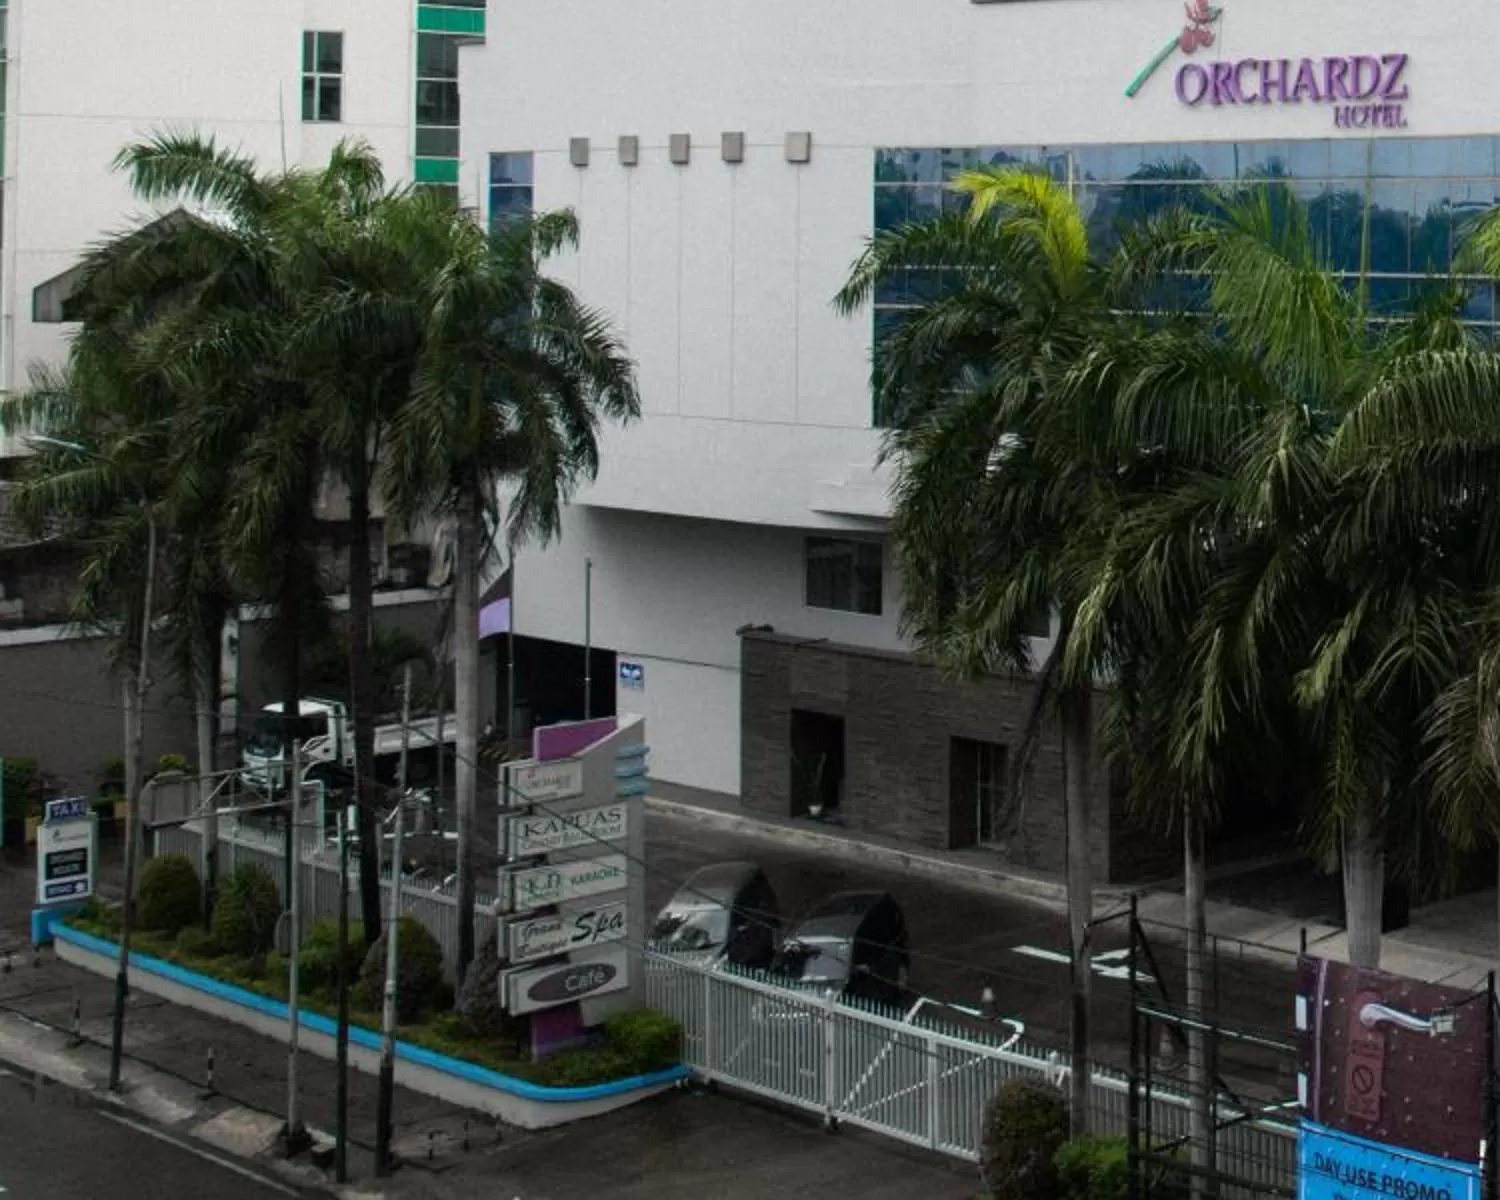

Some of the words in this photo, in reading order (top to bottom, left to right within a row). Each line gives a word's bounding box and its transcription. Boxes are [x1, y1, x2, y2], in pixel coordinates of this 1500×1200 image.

[1174, 53, 1409, 107] ORCHARDZ
[1333, 103, 1409, 129] HOTEL
[51, 801, 86, 818] TAXI
[525, 807, 621, 837] KAPUAS
[571, 911, 623, 942] Spa
[566, 966, 605, 991] Café
[1314, 1152, 1345, 1179] DAY
[1347, 1165, 1377, 1190] USE
[1381, 1174, 1451, 1200] PROMO
